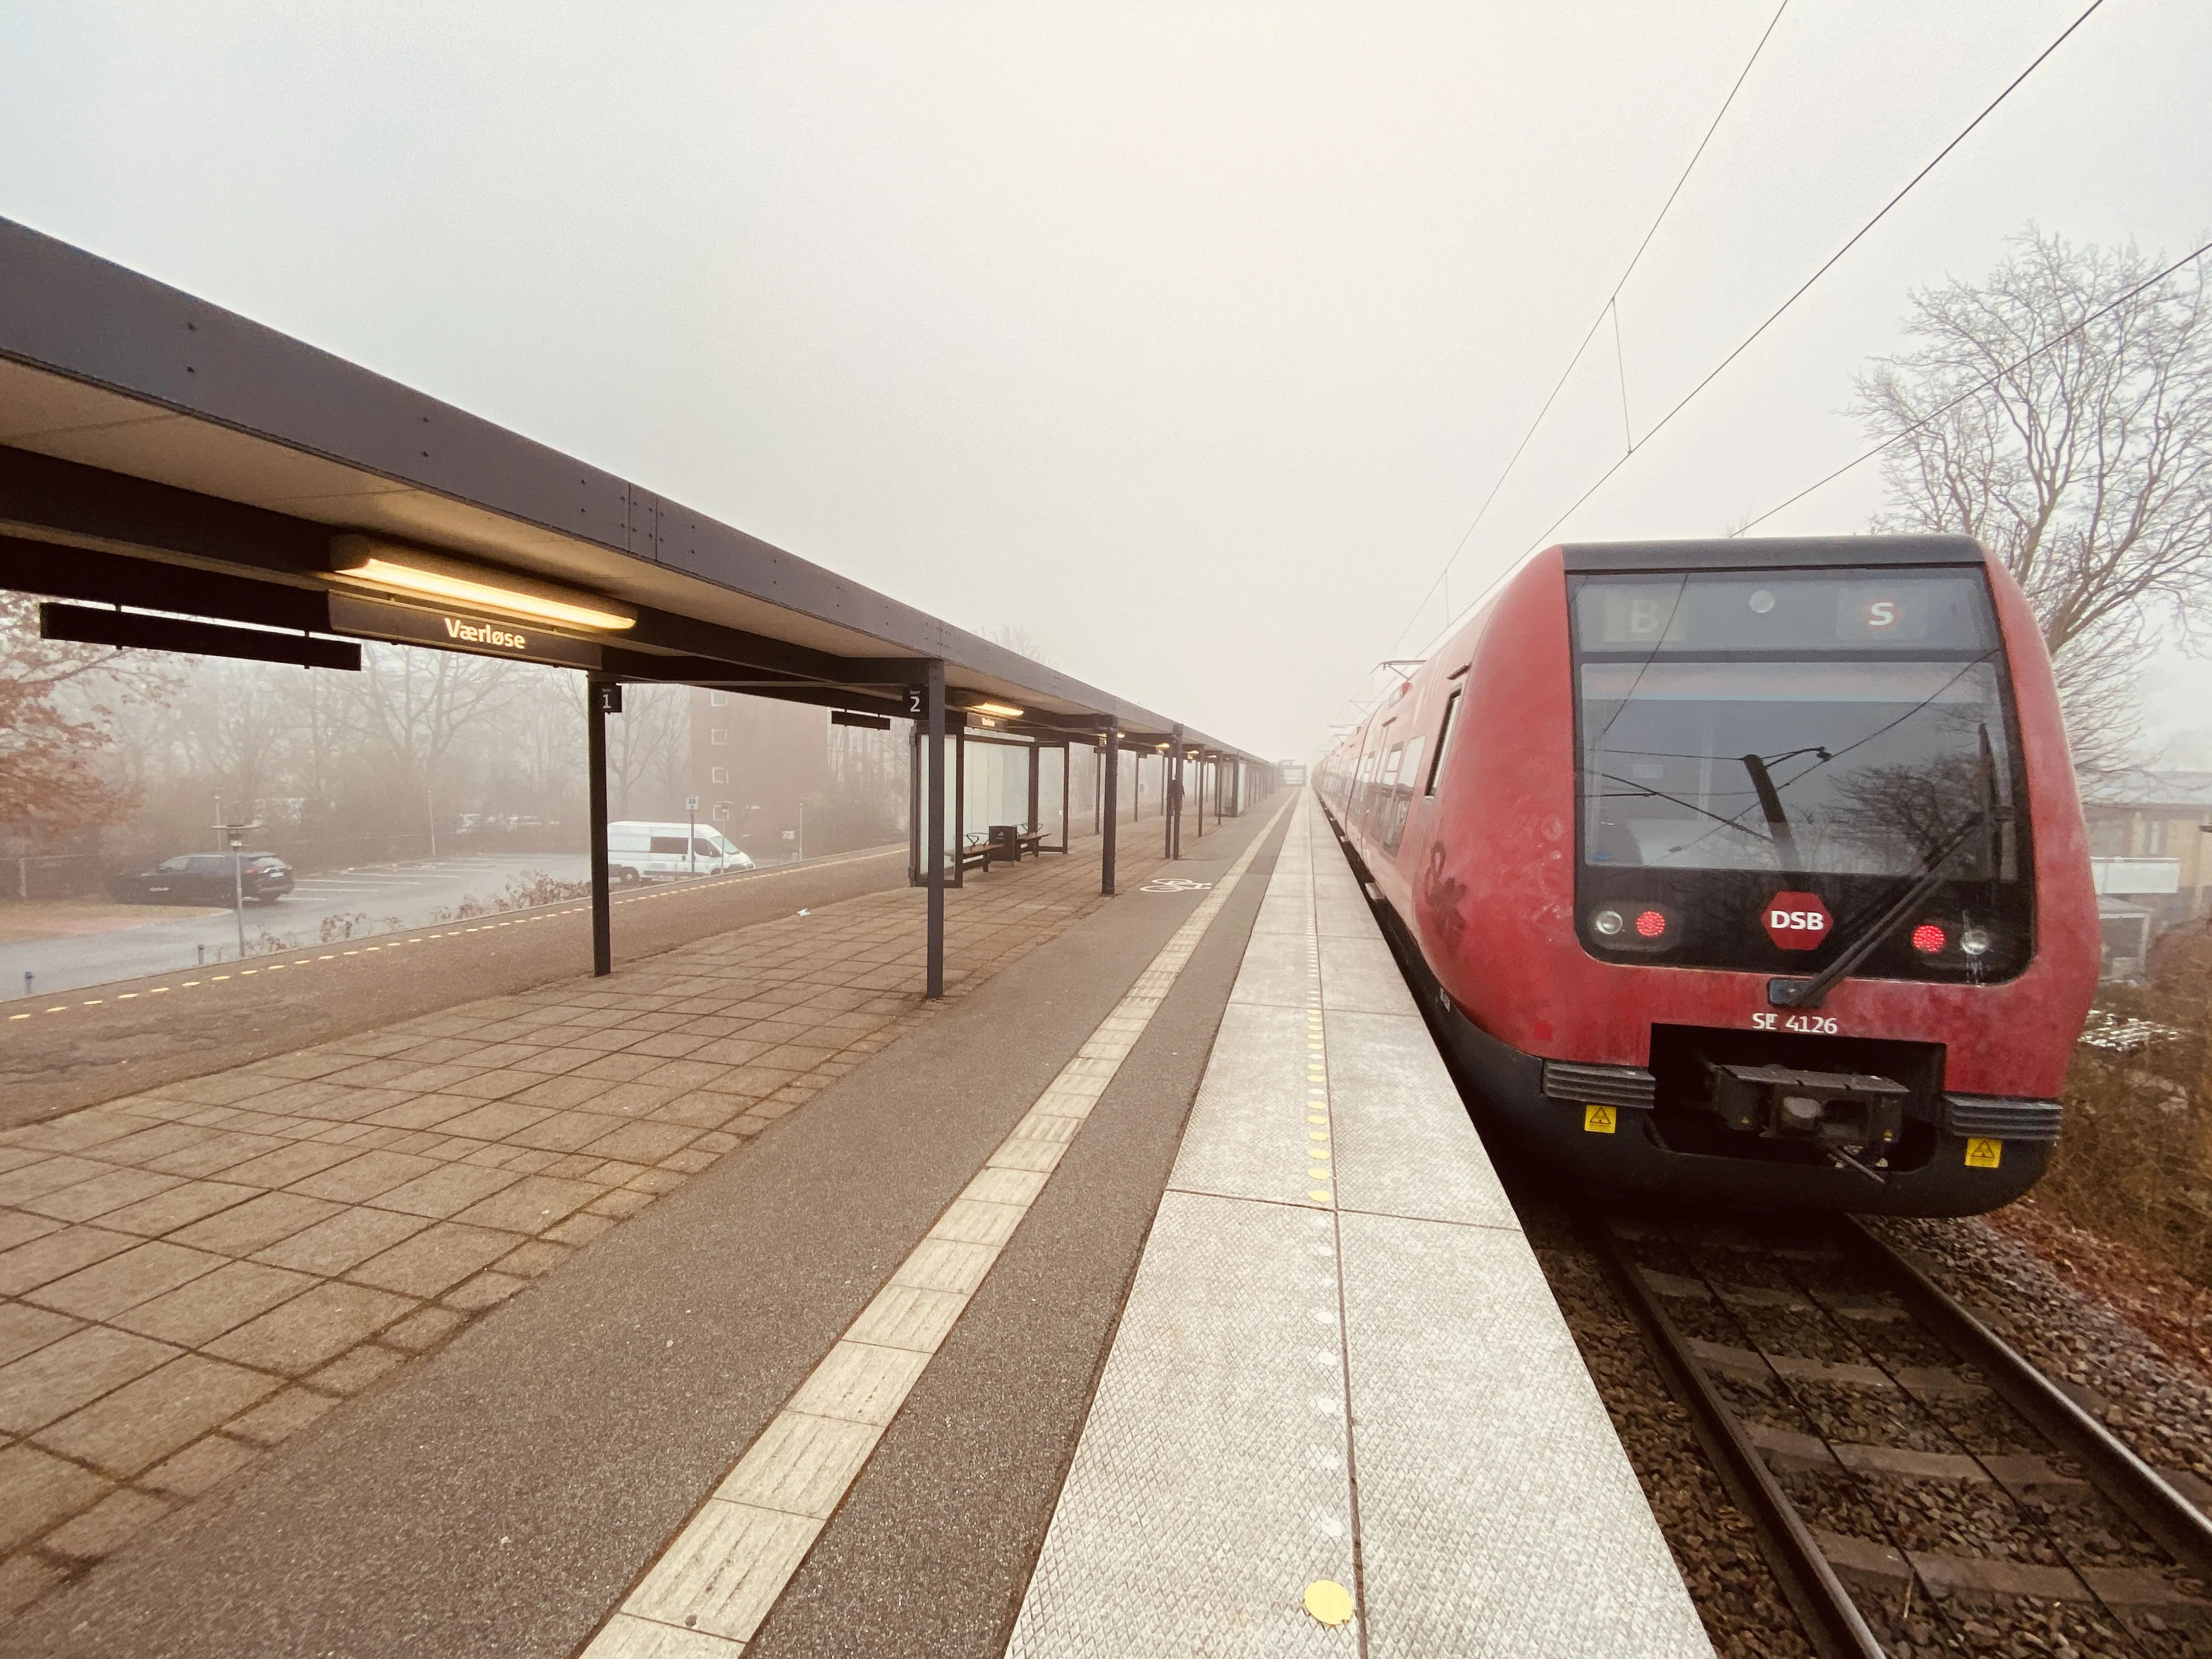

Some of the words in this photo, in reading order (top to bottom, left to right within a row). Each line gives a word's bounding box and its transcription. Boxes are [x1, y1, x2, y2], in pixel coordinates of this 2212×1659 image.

[1631, 599, 1658, 633] B
[1869, 602, 1893, 625] S
[444, 617, 526, 649] Værløse
[603, 693, 611, 708] 1
[910, 696, 921, 712] 2
[1771, 910, 1824, 930] DSB
[1752, 1012, 1778, 1030] SE
[1785, 1015, 1837, 1034] 4126
